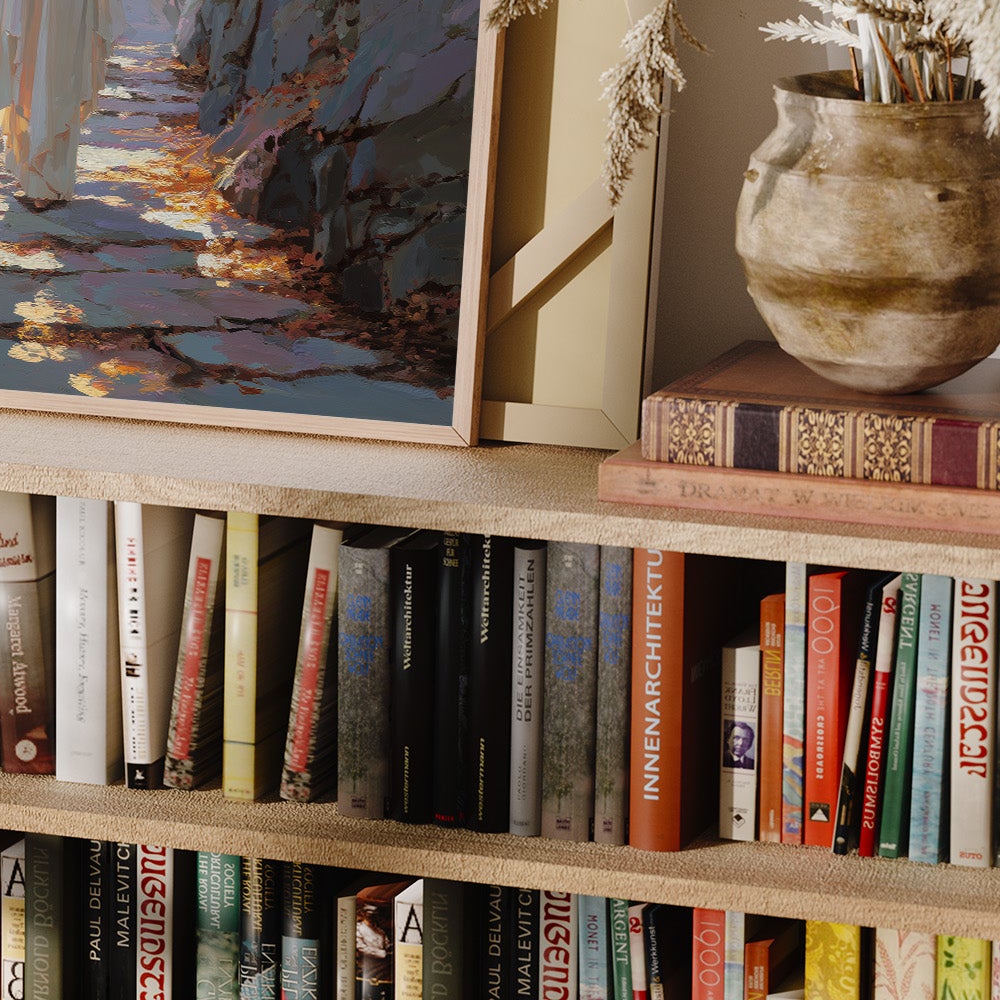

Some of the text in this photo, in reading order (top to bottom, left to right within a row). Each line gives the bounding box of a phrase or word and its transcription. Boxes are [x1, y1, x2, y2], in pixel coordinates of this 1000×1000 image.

[8, 596, 32, 714] Margaret Atwood
[403, 563, 413, 671] Weltarchitektur
[515, 574, 526, 722] DIE EINSAMKEIT
[524, 559, 536, 722] DER PRIMZAHLEN
[643, 549, 664, 801] INNENARCHITEKTU
[477, 737, 486, 821] westermann
[89, 839, 101, 961] PAUL DELVAU
[400, 904, 423, 943] A
[489, 885, 502, 965] DELVAU
[585, 914, 598, 953] MONET
[612, 901, 629, 966] ARGENT
[650, 926, 660, 975] Werkkunst
[699, 921, 721, 987] 1900
